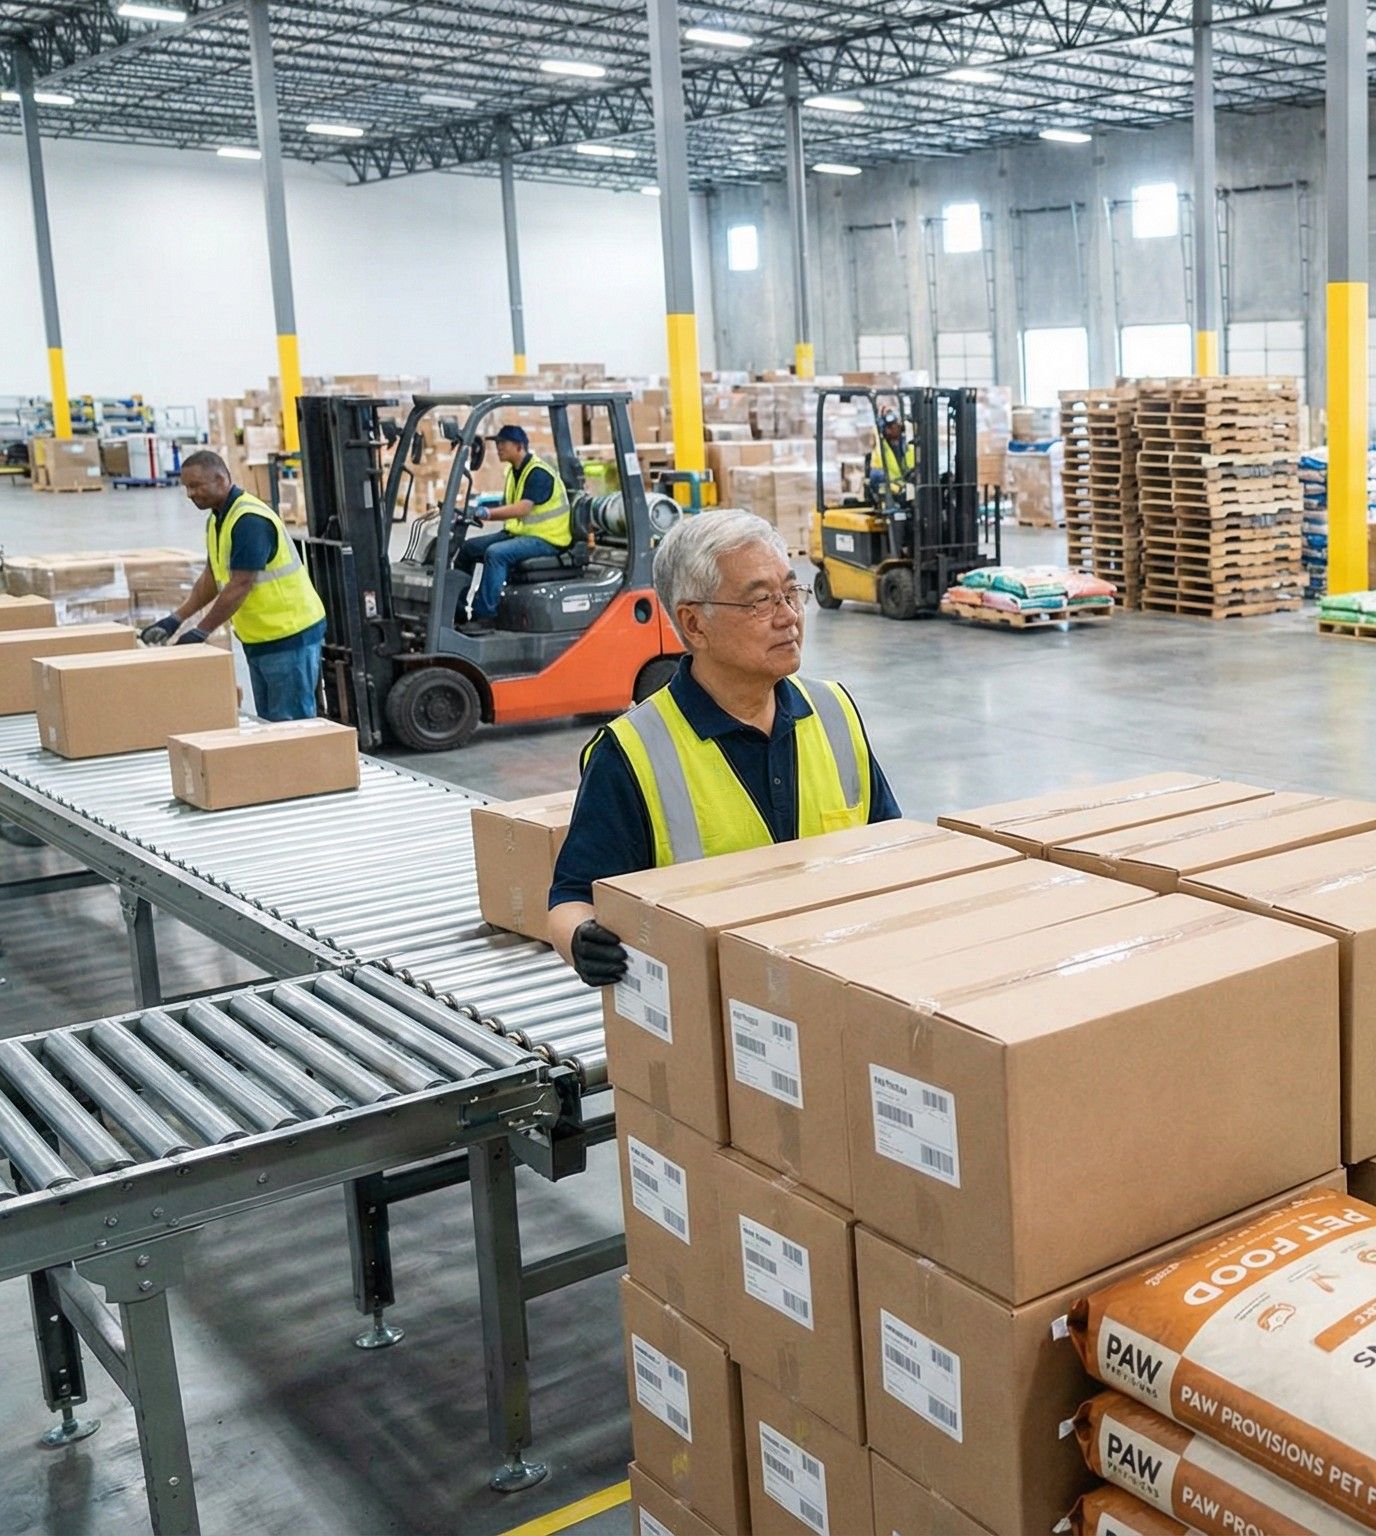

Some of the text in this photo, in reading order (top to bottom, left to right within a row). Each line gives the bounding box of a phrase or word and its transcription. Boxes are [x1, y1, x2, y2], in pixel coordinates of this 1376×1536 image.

[1299, 1208, 1372, 1242] PET
[1184, 1237, 1301, 1306] FOOD
[1106, 1333, 1163, 1384] PAW
[1107, 1432, 1163, 1485] PAW
[1181, 1385, 1218, 1417] PAW
[1221, 1406, 1325, 1477] PROVISIONS
[1329, 1465, 1364, 1499] PET
[1182, 1486, 1219, 1520] PAW
